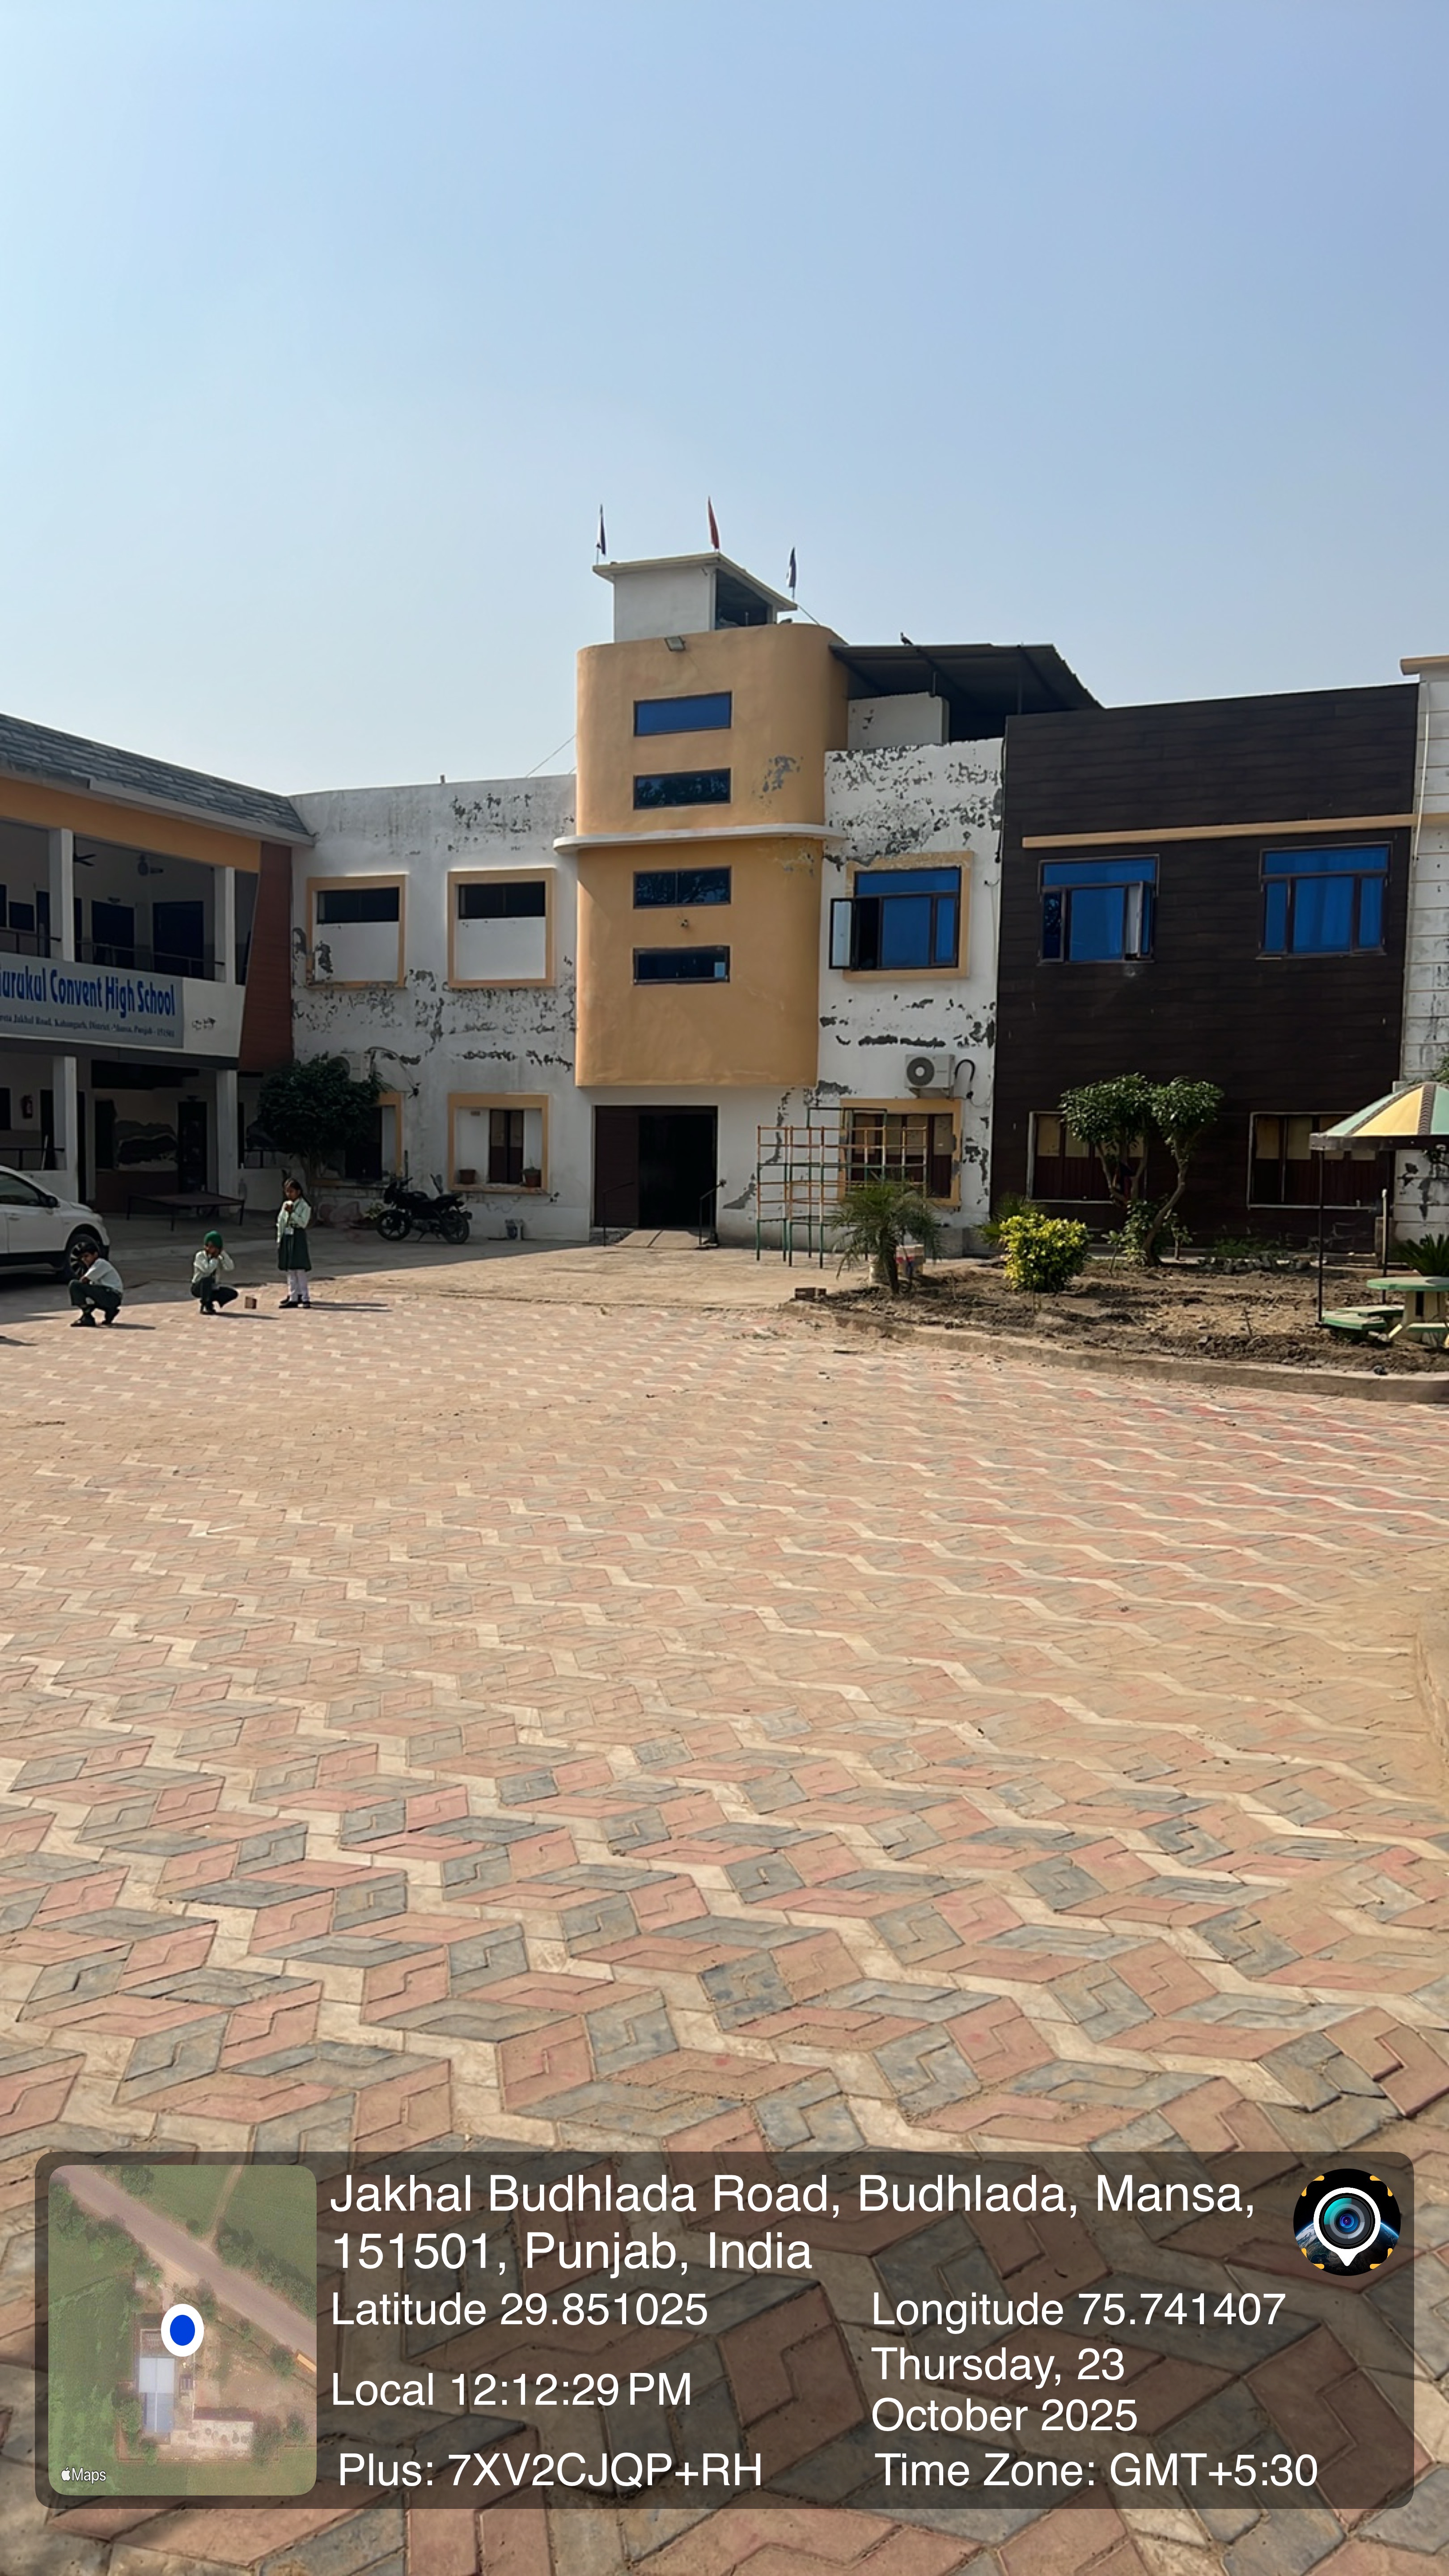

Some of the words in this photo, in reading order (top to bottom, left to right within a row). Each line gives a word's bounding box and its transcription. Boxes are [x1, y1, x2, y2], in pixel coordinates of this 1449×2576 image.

[0, 965, 47, 1002] urukul
[50, 969, 102, 1008] Convent
[106, 976, 135, 1018] High
[137, 980, 175, 1016] School
